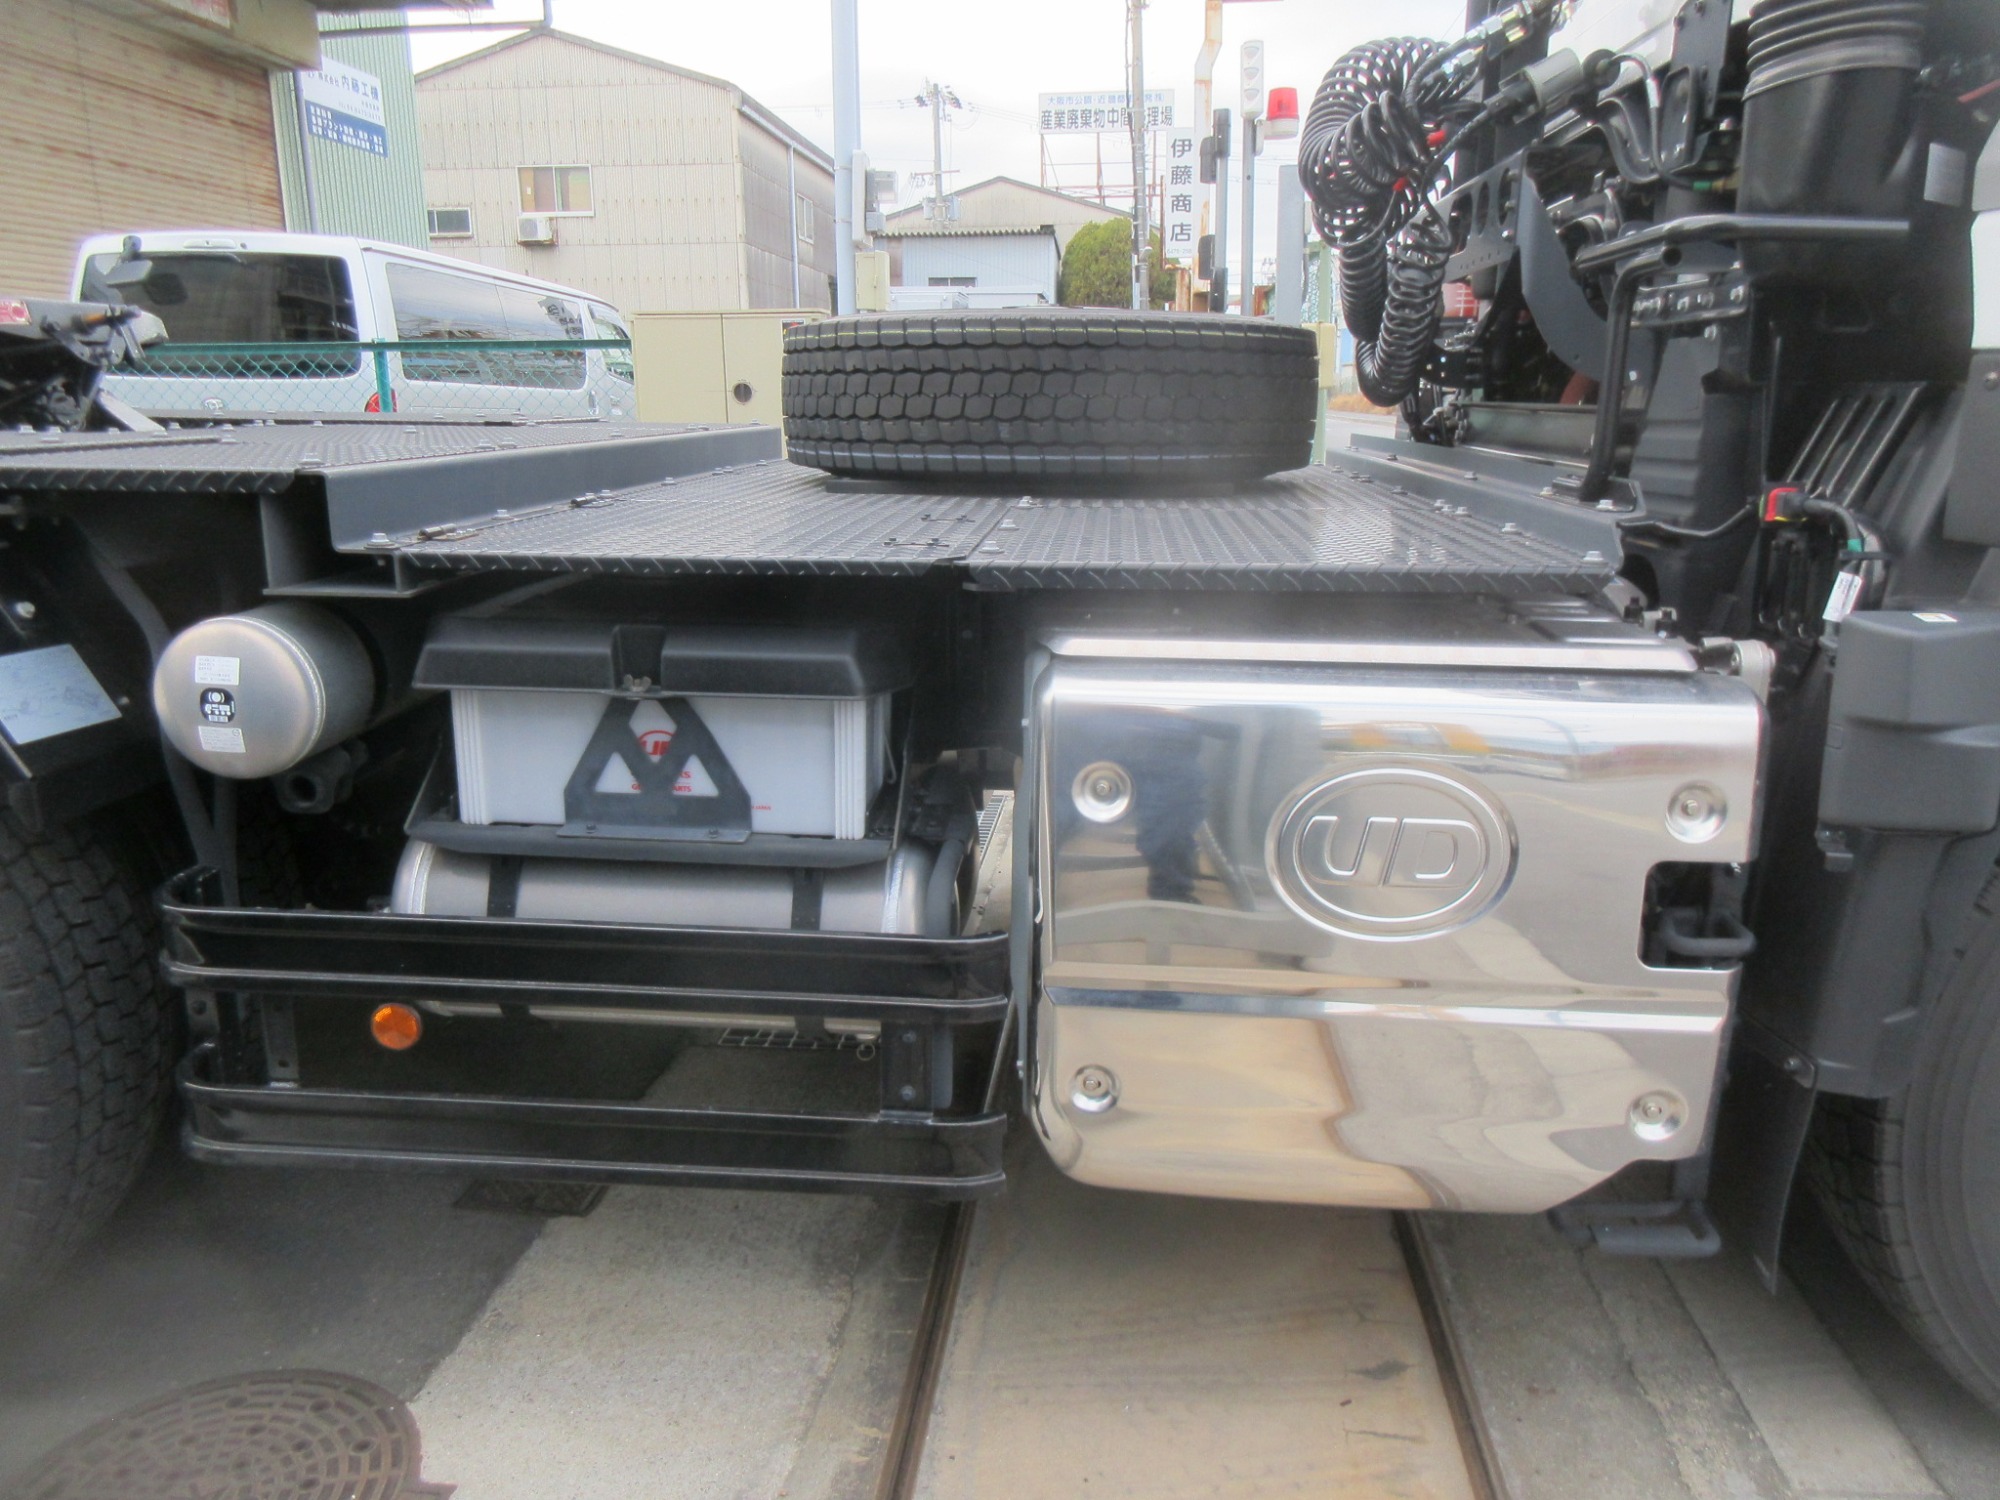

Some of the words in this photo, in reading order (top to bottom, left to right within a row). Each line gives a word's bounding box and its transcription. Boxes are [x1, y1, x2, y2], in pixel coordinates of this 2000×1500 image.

[1041, 106, 1173, 130] 産業廃棄物中間理場
[1170, 138, 1193, 242] 伊藤商店
[1301, 815, 1486, 888] UD
